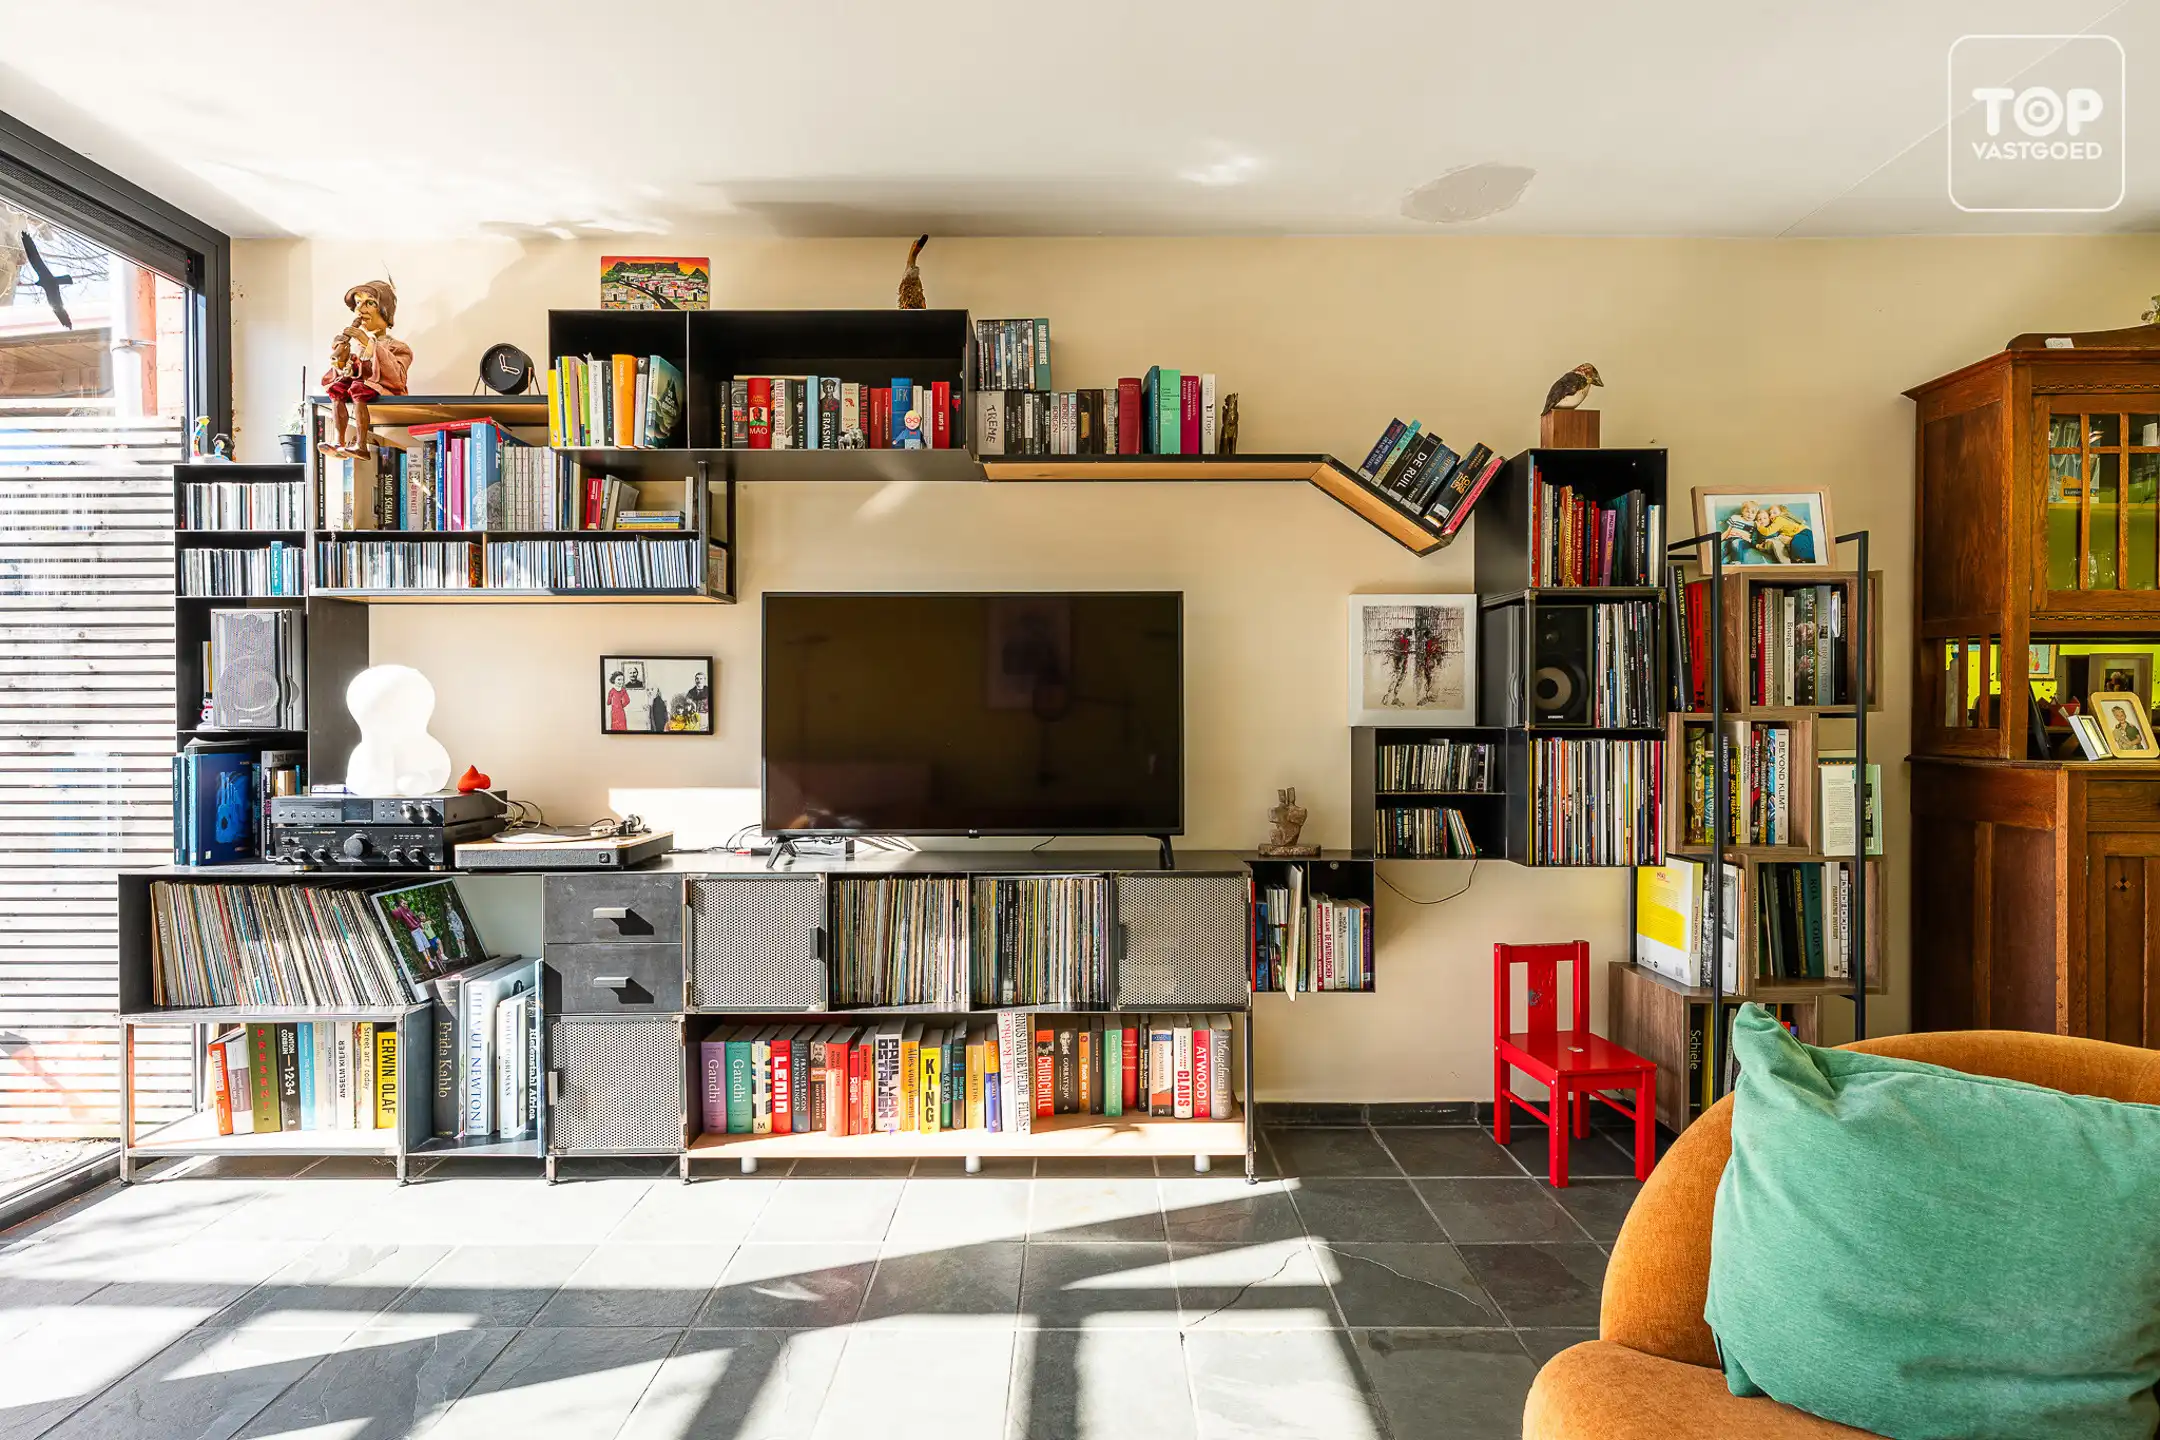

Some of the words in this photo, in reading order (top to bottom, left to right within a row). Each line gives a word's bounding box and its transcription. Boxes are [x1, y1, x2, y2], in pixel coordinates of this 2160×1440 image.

[750, 427, 768, 435] MAO
[1413, 452, 1427, 468] DE
[384, 474, 393, 495] SIMON
[1396, 467, 1416, 488] RUIL
[384, 497, 393, 524] SCHAMA
[1810, 879, 1819, 900] ROA
[1812, 920, 1821, 957] CODEX
[470, 992, 482, 1052] HELMUT
[1015, 1013, 1026, 1038] RINUS
[363, 1027, 371, 1049] Street
[439, 1021, 453, 1056] Frida
[1001, 1019, 1012, 1057] Rothko
[1016, 1040, 1027, 1056] VAN
[1690, 1030, 1702, 1070] Schiele
[257, 1029, 271, 1112] PRESENT
[382, 1038, 396, 1077] ERWIN
[528, 1028, 537, 1087] Riefenstahl
[888, 1039, 899, 1080] PAUL
[907, 1048, 917, 1067] Alles
[1003, 1059, 1012, 1085] Mark
[1017, 1056, 1027, 1069] DE
[1196, 1046, 1206, 1098] ATWOOD
[362, 1069, 371, 1090] today
[439, 1059, 452, 1098] Kahlo
[470, 1057, 482, 1121] NEWTON
[709, 1059, 721, 1103] Gandhi
[733, 1059, 746, 1103] Gandhi
[774, 1056, 787, 1113] LENIN
[908, 1069, 916, 1087] voor
[926, 1059, 935, 1123] KING
[943, 1072, 951, 1103] KAFKA
[1017, 1070, 1028, 1096] VELDE
[1037, 1056, 1052, 1109] CHURCHILL
[1177, 1070, 1190, 1106] CLAUS
[382, 1083, 396, 1114] OLAF
[529, 1088, 538, 1120] Africa
[908, 1090, 918, 1118] Vincent
[1018, 1101, 1028, 1127] FILMS
